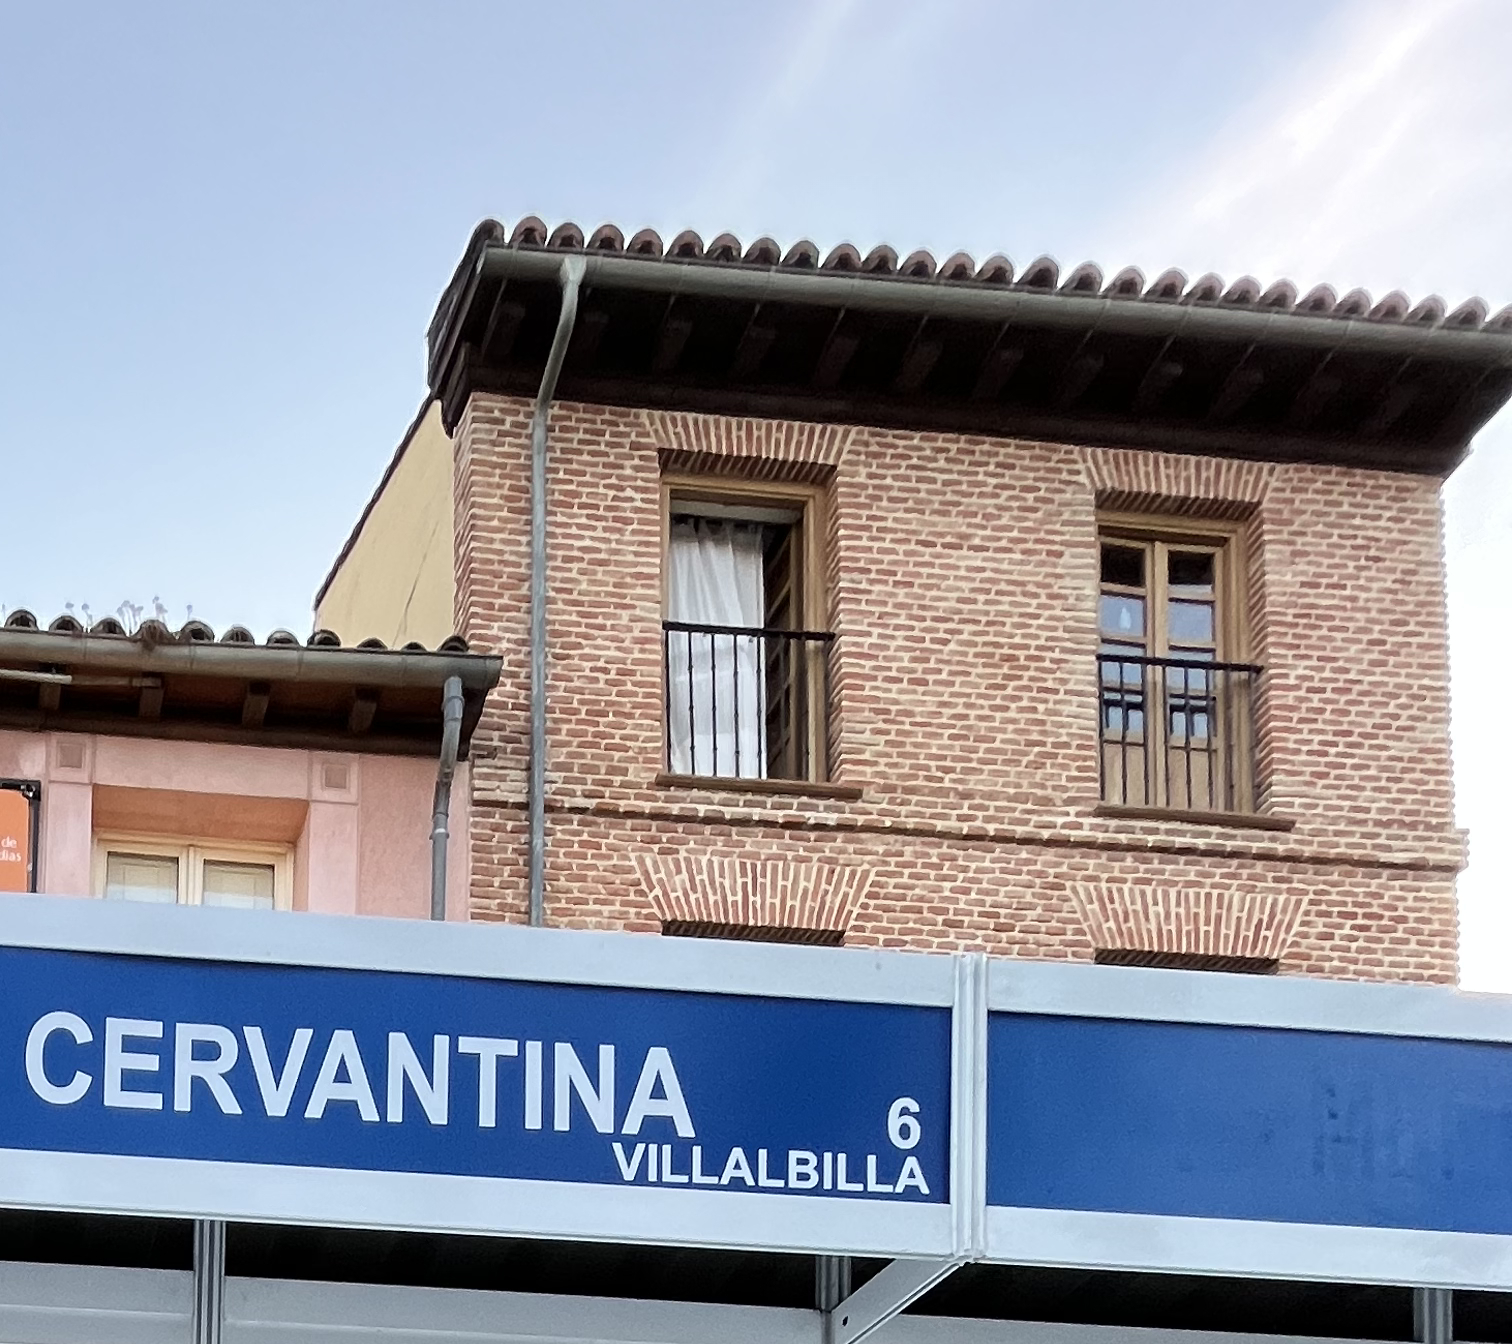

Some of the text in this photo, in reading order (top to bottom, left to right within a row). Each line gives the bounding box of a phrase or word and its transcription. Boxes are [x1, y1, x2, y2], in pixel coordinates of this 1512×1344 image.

[1, 836, 18, 849] de
[25, 1011, 696, 1138] CERVANTINA
[887, 1097, 921, 1150] 6
[611, 1142, 930, 1195] VILLALBILLA
